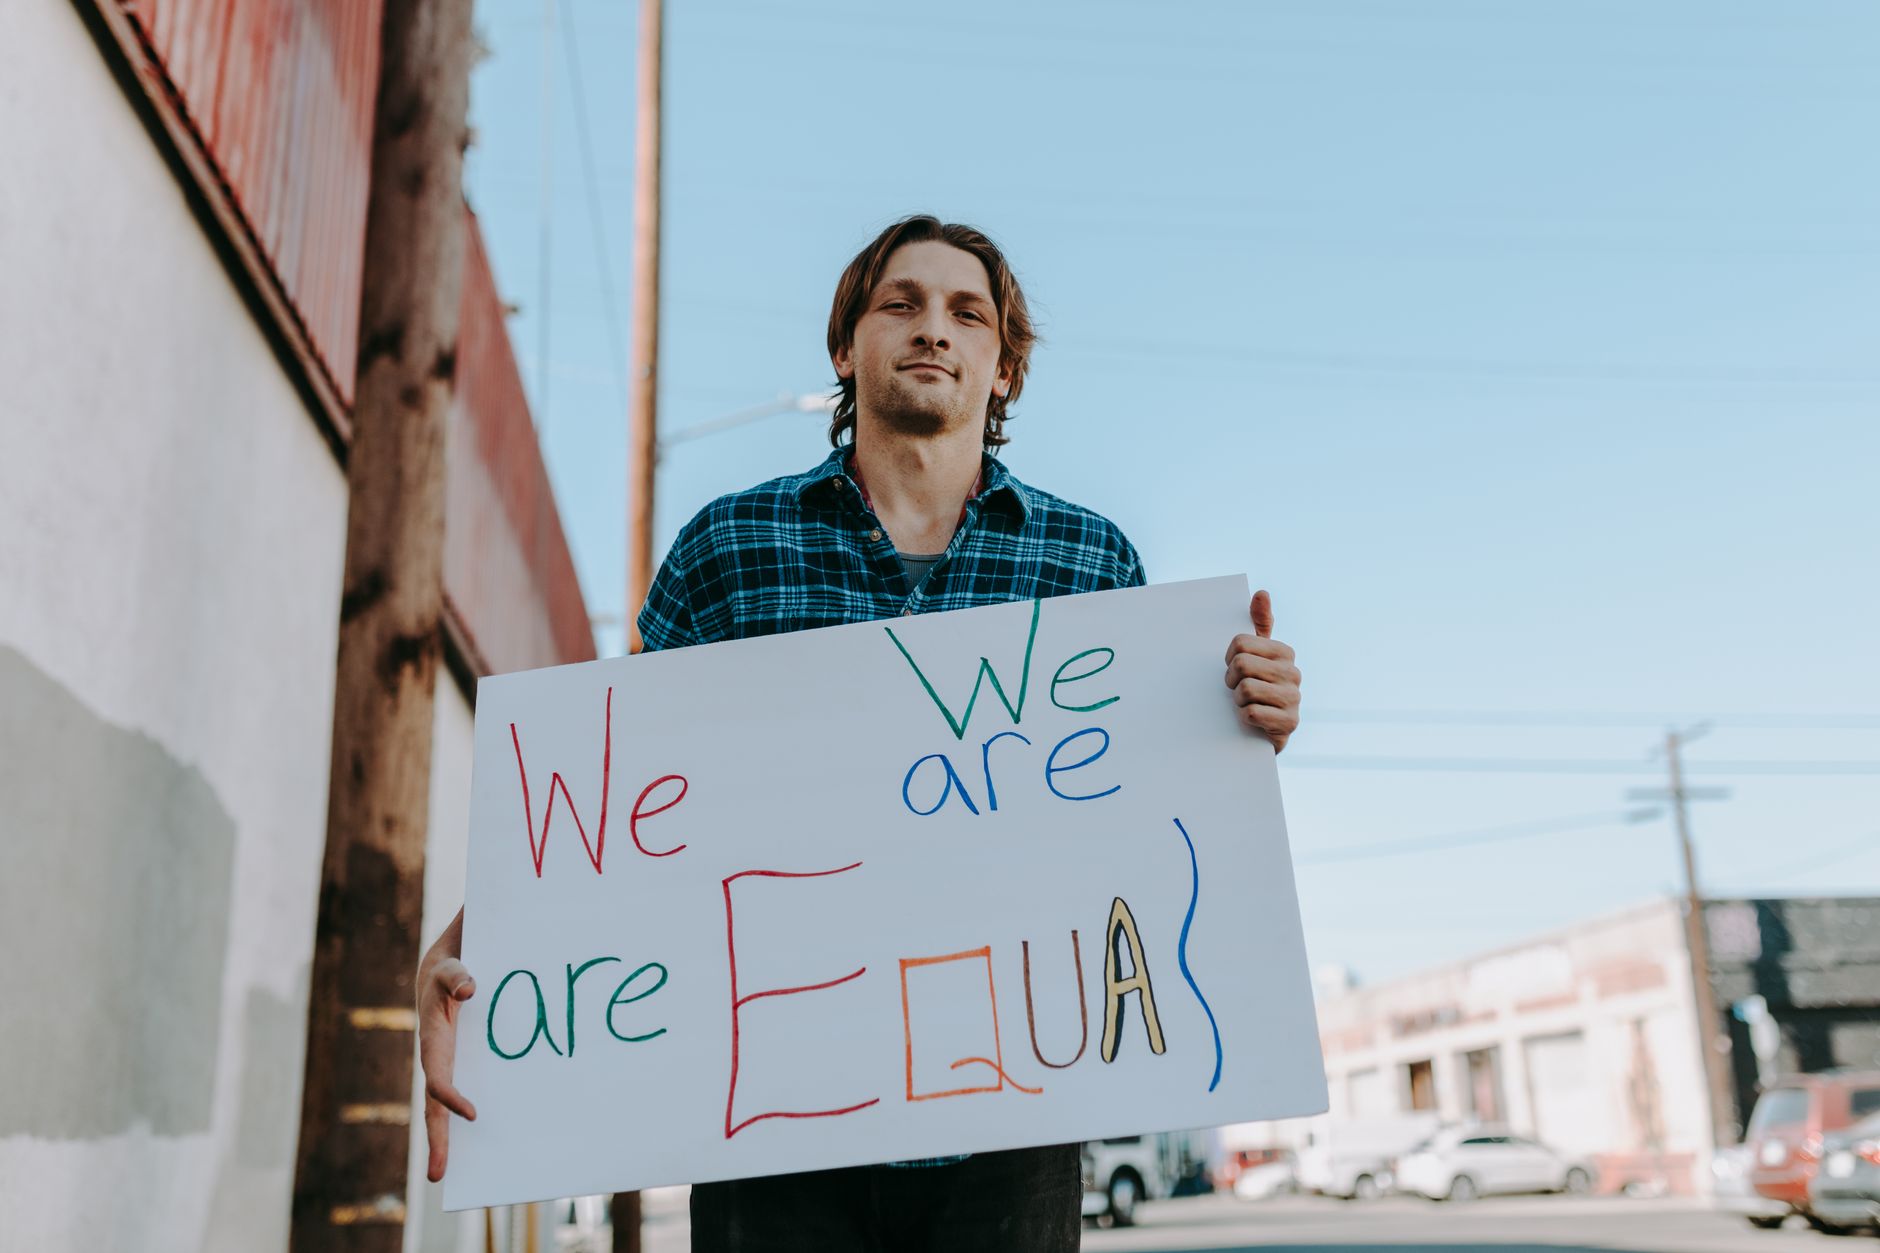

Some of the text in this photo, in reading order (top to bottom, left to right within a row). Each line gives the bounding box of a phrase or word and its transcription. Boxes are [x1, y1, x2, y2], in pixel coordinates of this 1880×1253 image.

[886, 598, 1120, 739] We
[510, 687, 690, 878] We
[902, 727, 1122, 816] are
[487, 956, 669, 1060] are
